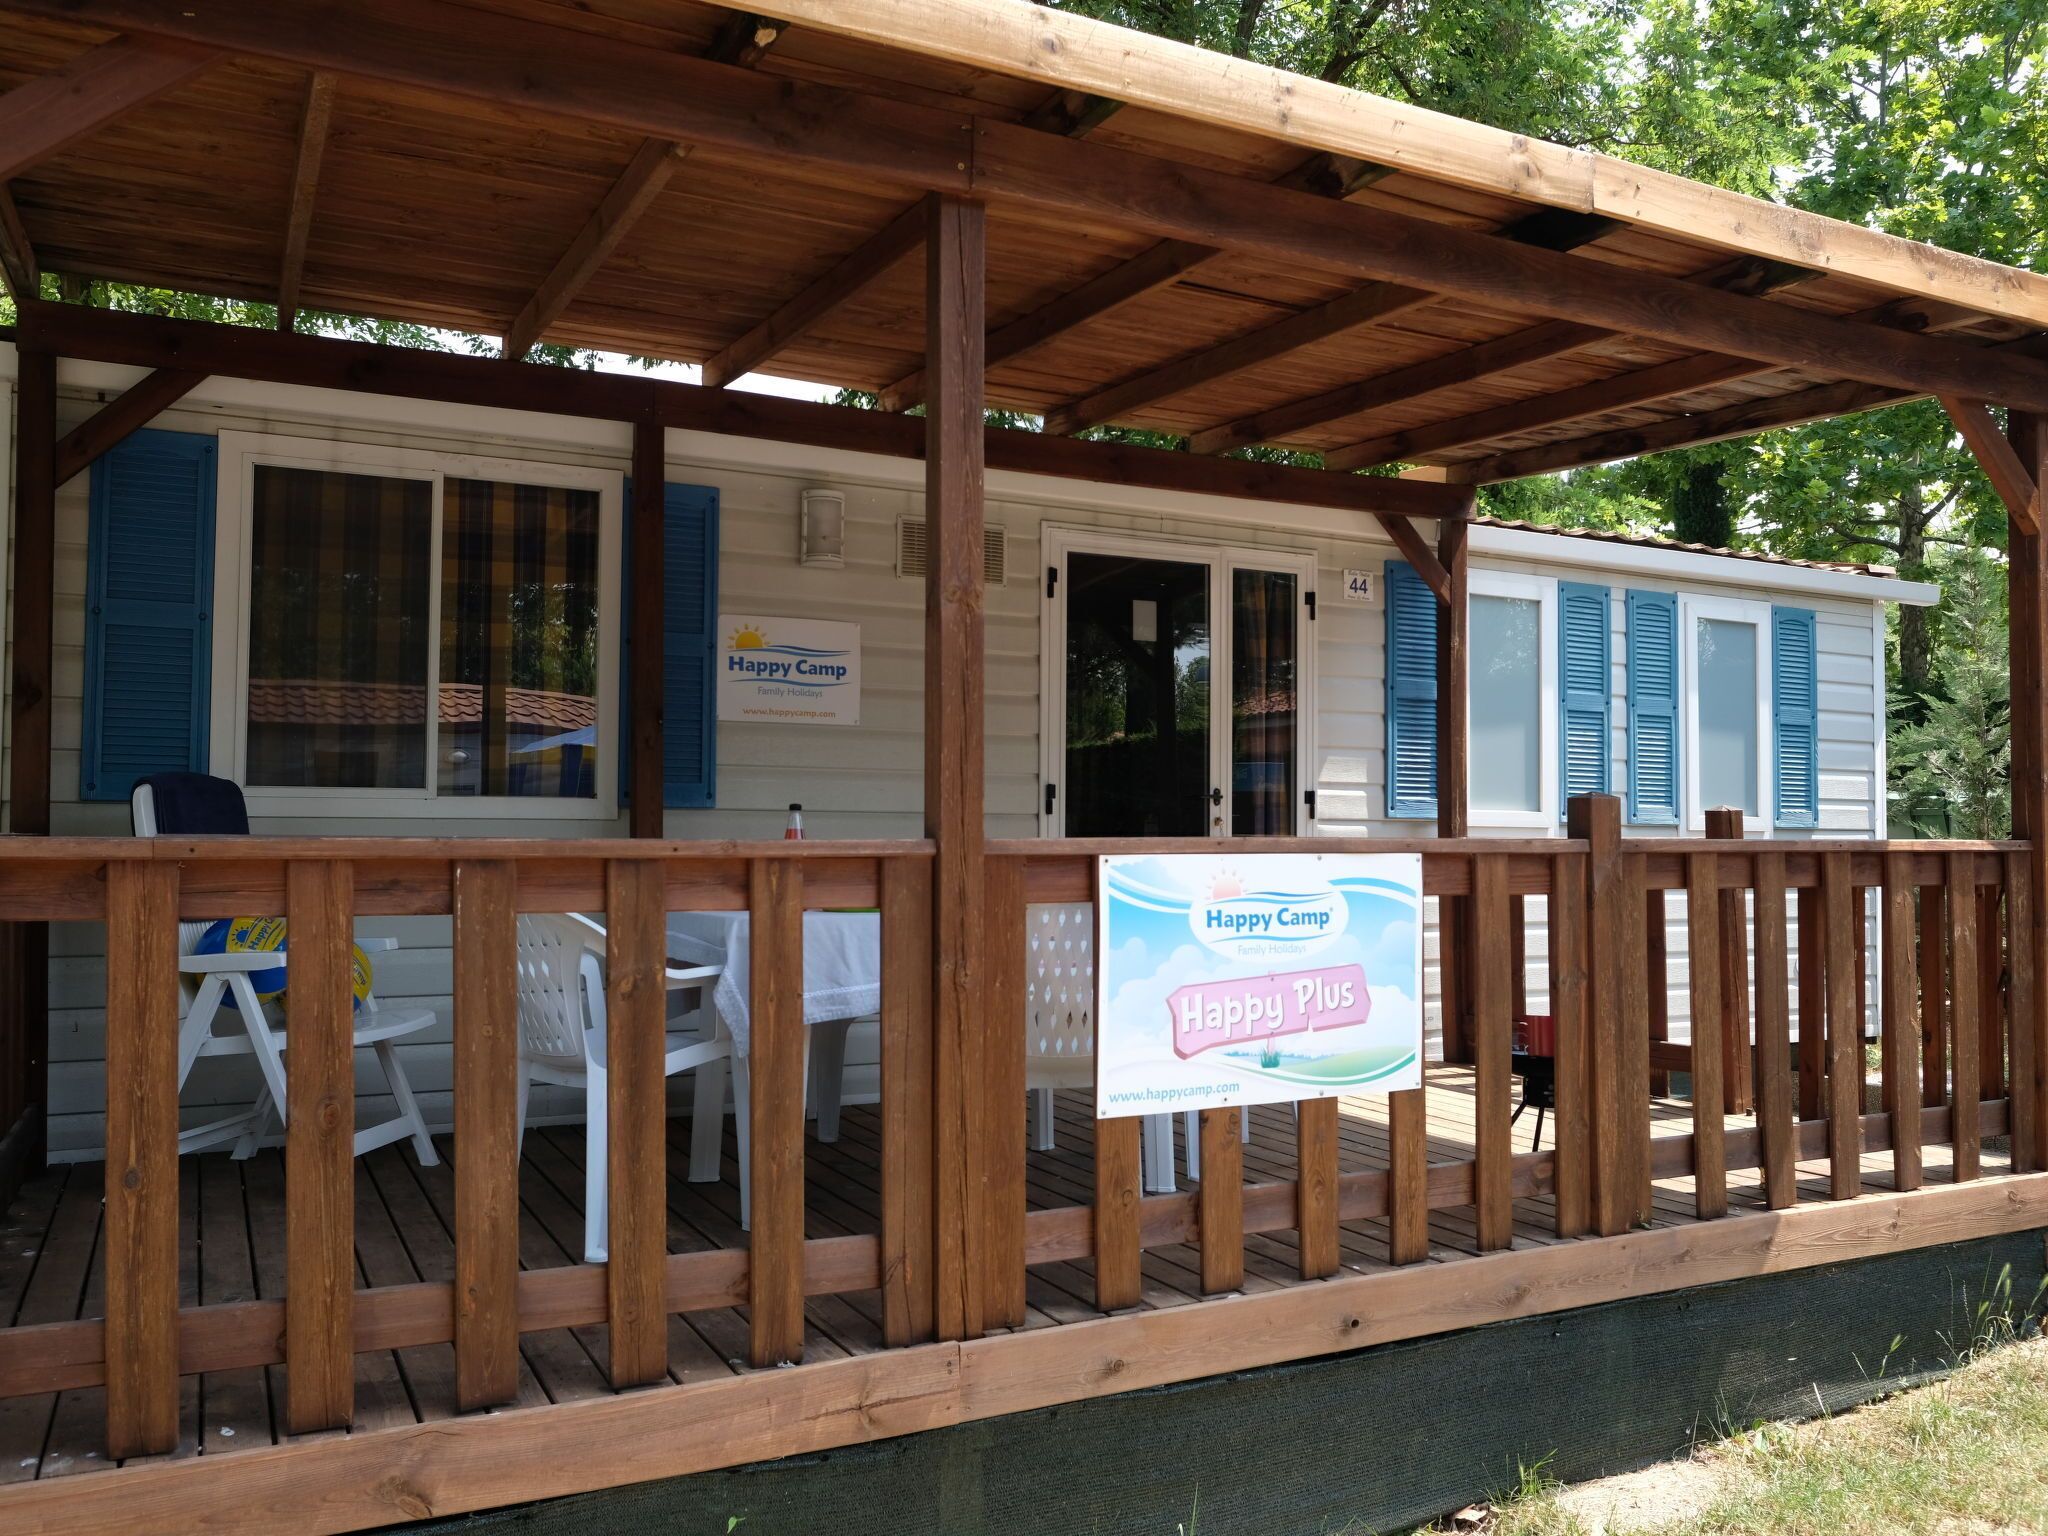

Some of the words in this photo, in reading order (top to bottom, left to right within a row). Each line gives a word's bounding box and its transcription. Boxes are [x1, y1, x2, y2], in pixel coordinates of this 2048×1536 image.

[1349, 577, 1368, 594] 44
[728, 656, 791, 677] Happy
[795, 659, 847, 680] Camp
[757, 686, 785, 698] Family
[787, 687, 822, 699] Holidays
[742, 707, 836, 719] www.happycamp.com
[1206, 909, 1273, 933] Happy
[1276, 907, 1330, 930] Camp
[248, 923, 272, 950] Happy
[1238, 944, 1266, 956] Family
[1268, 943, 1307, 954] Holidays
[1180, 992, 1285, 1039] Happy
[1293, 976, 1355, 1015] Plus
[1108, 1082, 1240, 1103] www.happycamp.com
